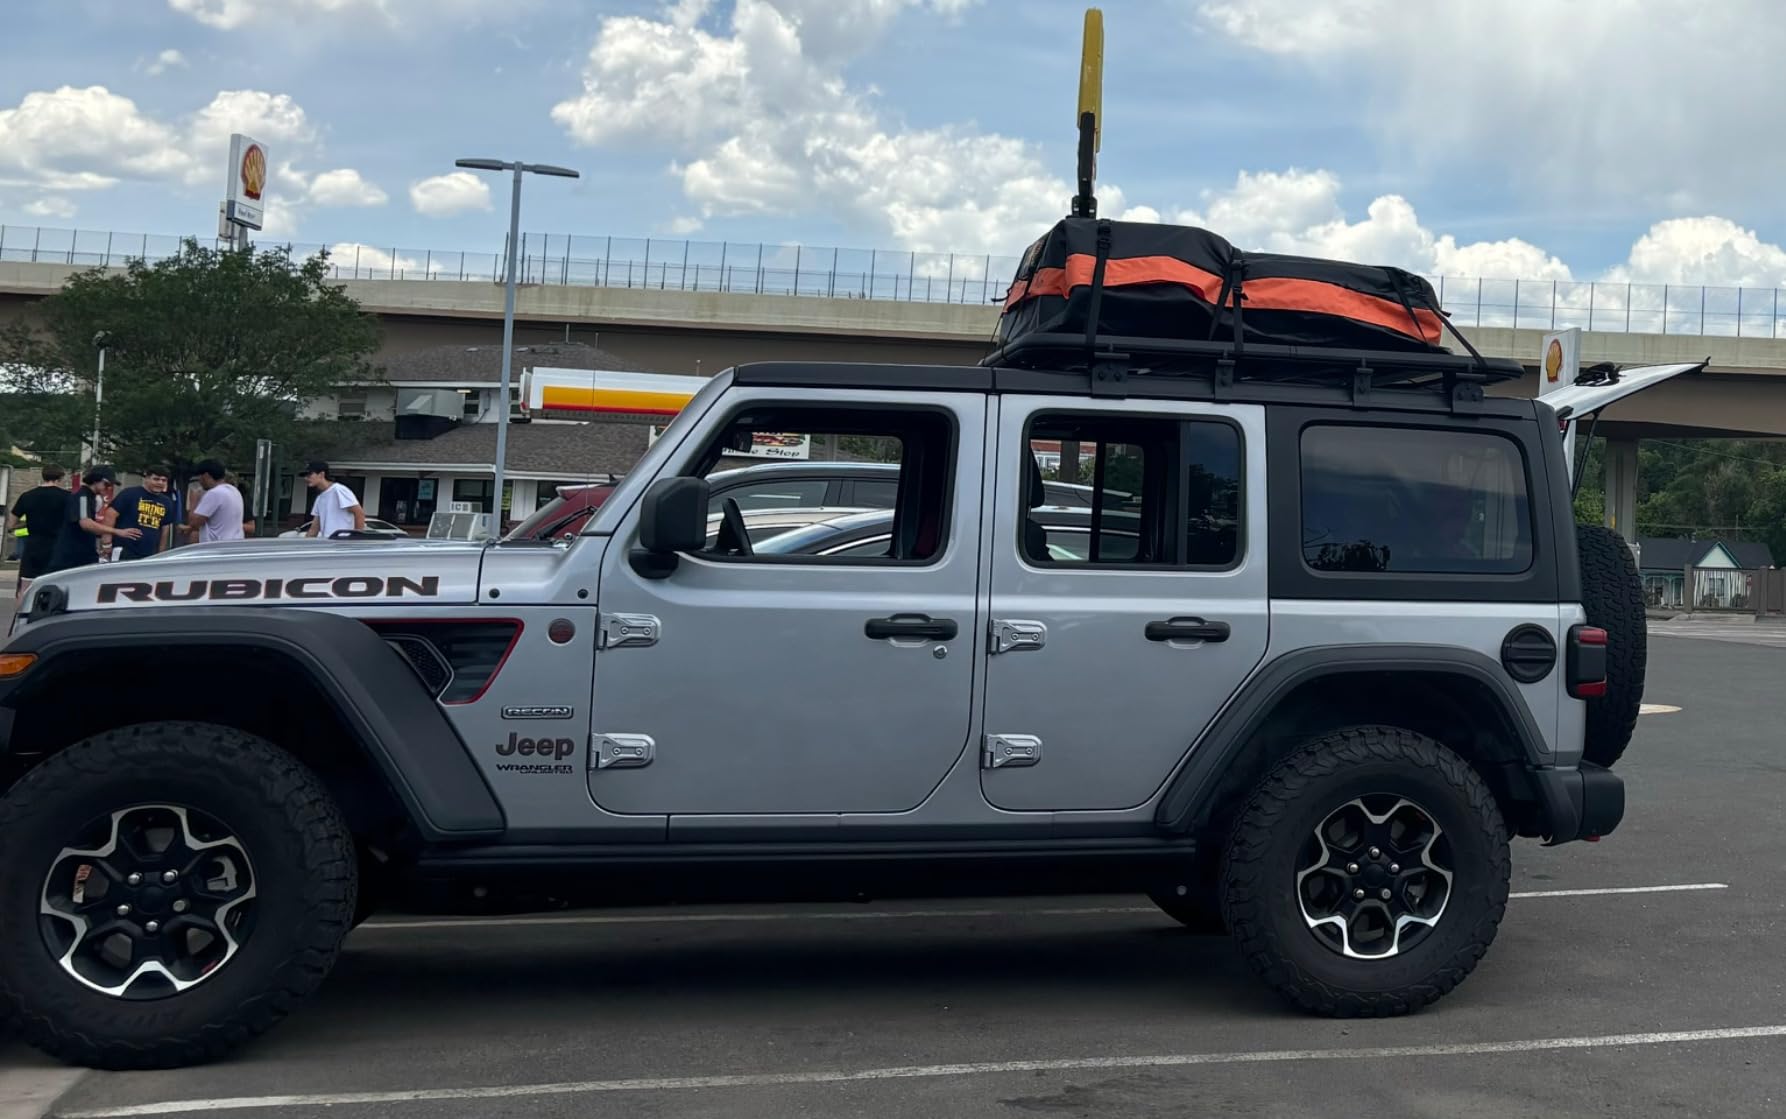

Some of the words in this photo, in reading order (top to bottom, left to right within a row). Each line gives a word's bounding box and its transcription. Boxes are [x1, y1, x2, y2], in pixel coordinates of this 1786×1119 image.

[451, 503, 469, 512] ICE
[98, 576, 439, 602] RUBICON
[496, 732, 574, 760] Jeep
[496, 764, 573, 772] WRANGLER
